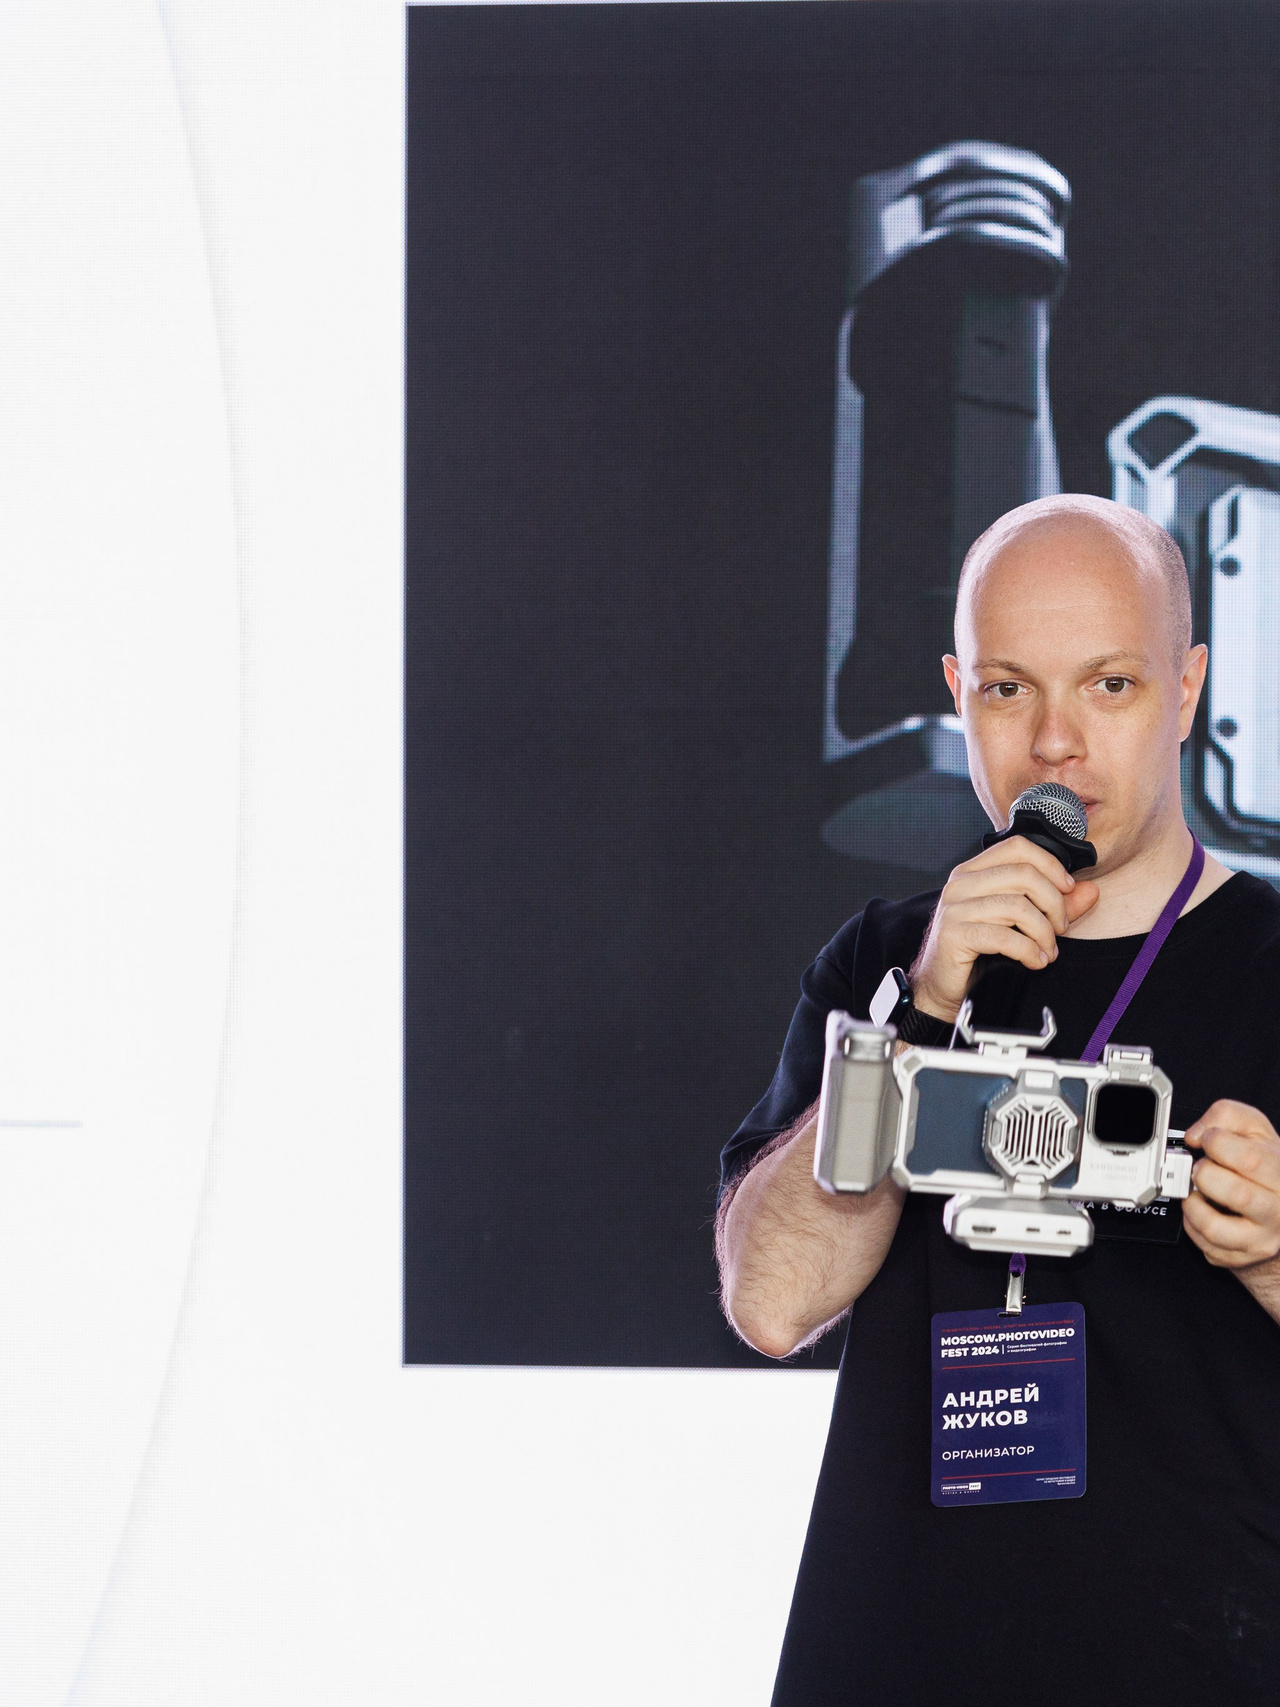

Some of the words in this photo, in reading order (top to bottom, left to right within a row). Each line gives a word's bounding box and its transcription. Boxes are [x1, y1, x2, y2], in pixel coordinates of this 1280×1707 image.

[1101, 1202, 1109, 1210] В
[941, 1328, 1075, 1346] MOSCOW.PHOTOVIDEO
[941, 1347, 970, 1358] FEST
[971, 1345, 1000, 1356] 2024
[942, 1383, 1039, 1409] АНДРЕЙ
[942, 1409, 1028, 1430] ЖУКОВ
[942, 1445, 1035, 1461] ОРГАНИЗАТОР
